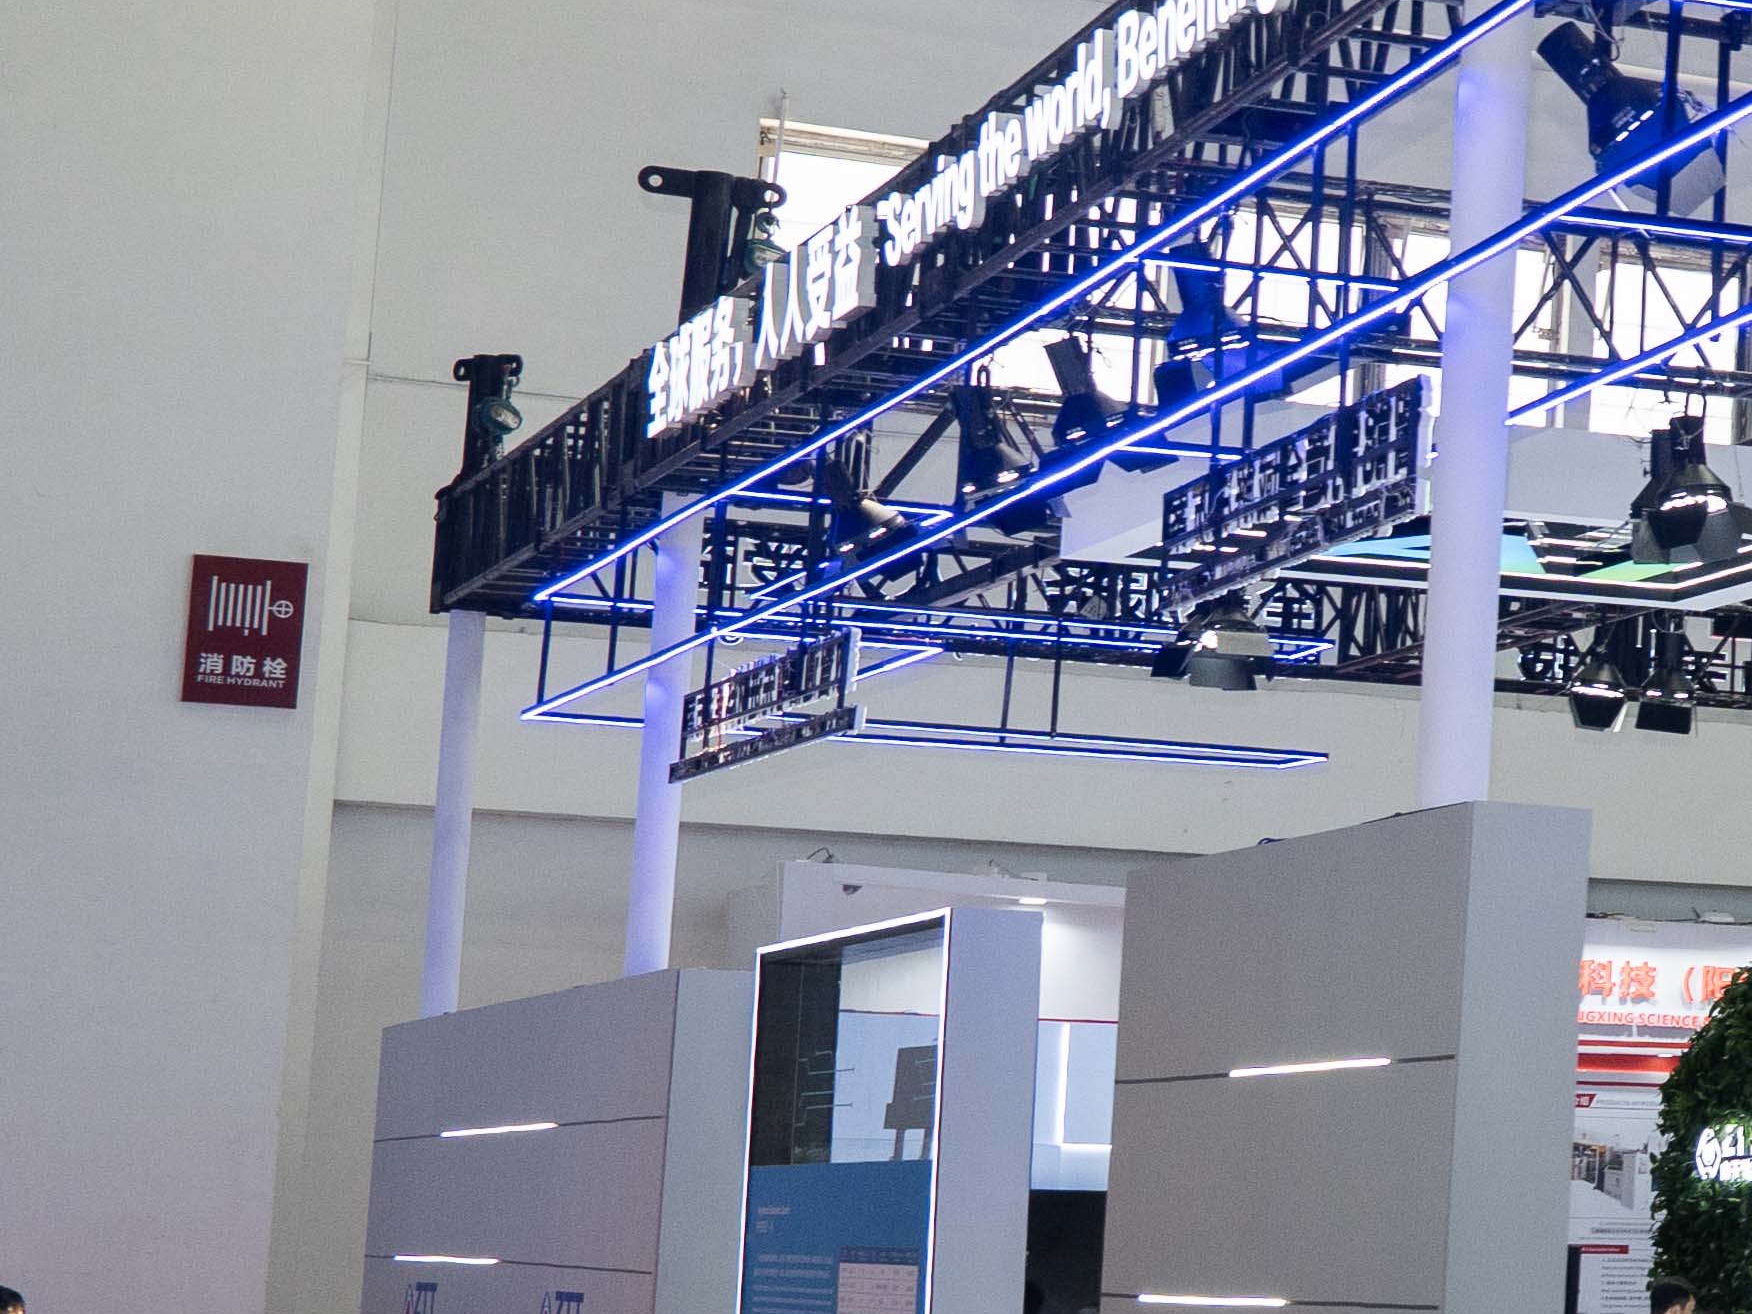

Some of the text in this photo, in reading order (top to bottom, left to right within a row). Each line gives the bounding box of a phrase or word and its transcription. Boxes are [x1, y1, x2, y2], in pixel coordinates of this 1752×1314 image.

[880, 157, 977, 266] Serving
[979, 110, 1022, 197] the
[1024, 48, 1113, 165] world,
[199, 652, 288, 679] 消防栓
[196, 674, 286, 688] FIRE HYDRANT
[1638, 1013, 1700, 1029] SCIENCE
